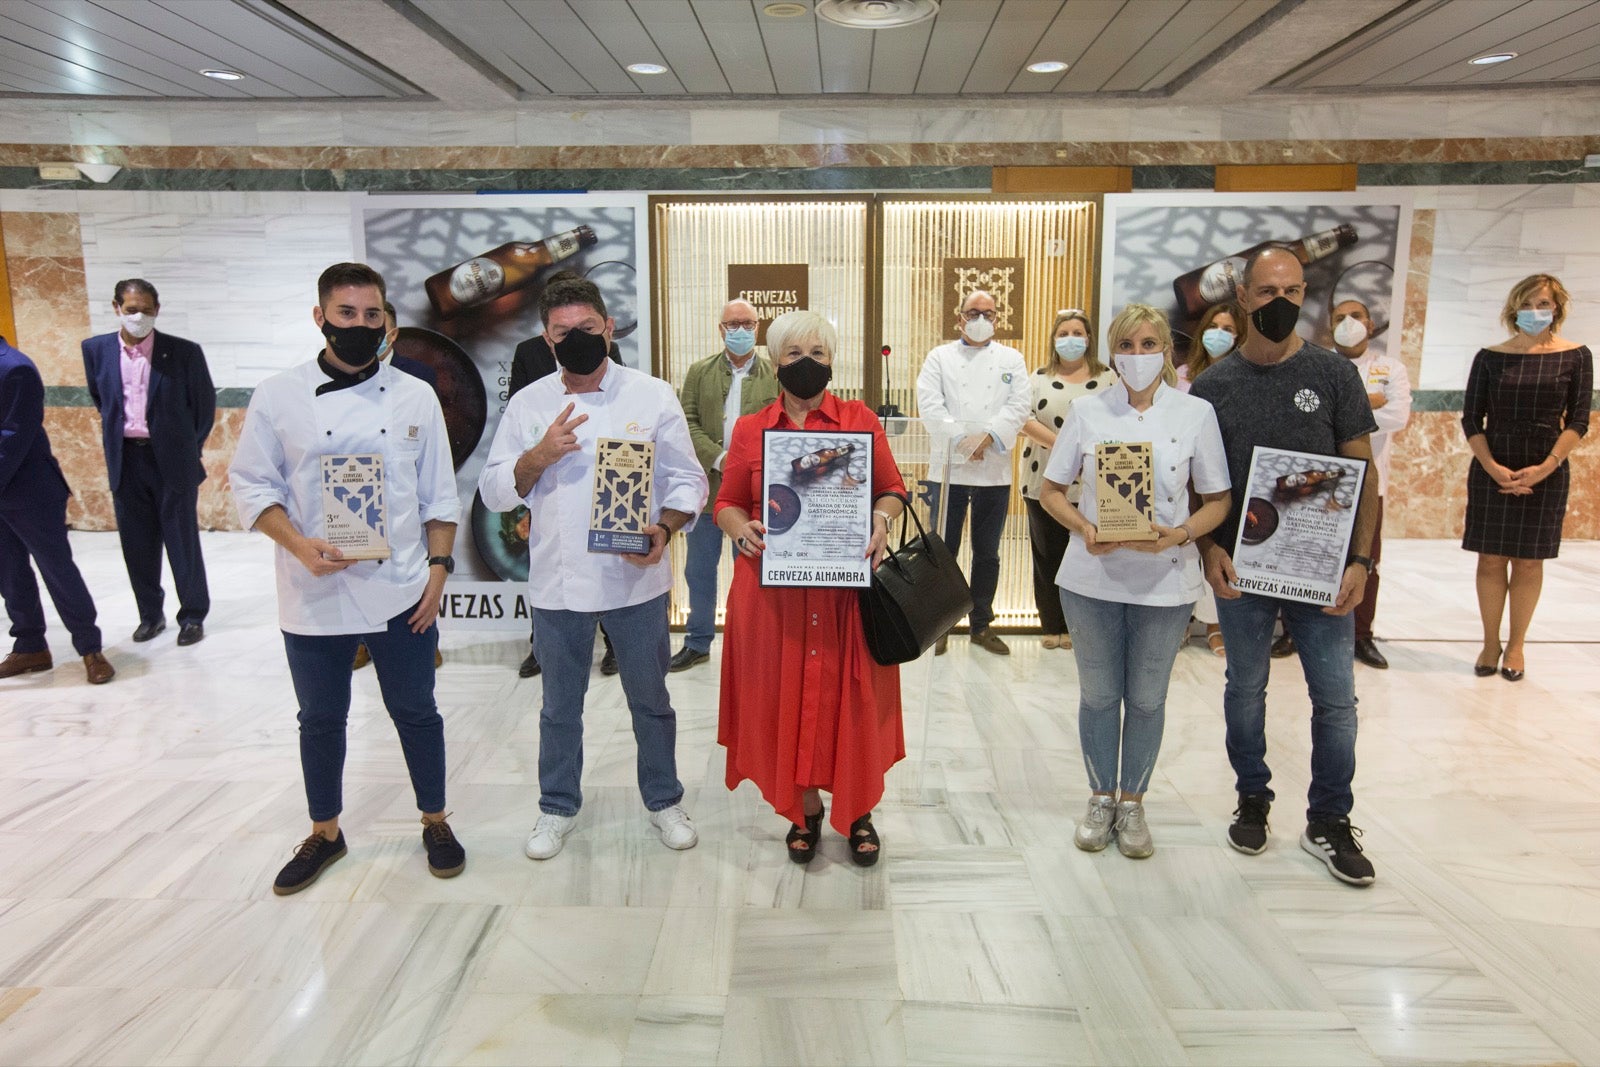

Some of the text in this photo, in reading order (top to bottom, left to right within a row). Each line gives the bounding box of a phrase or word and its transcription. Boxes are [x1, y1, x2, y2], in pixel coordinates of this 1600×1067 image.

[740, 290, 798, 305] CERVEZAS
[768, 570, 866, 583] CERVEZAS ALHAMBRA
[1234, 576, 1332, 603] CERVEZAS ALHAMBRA
[439, 594, 504, 619] VEZAS
